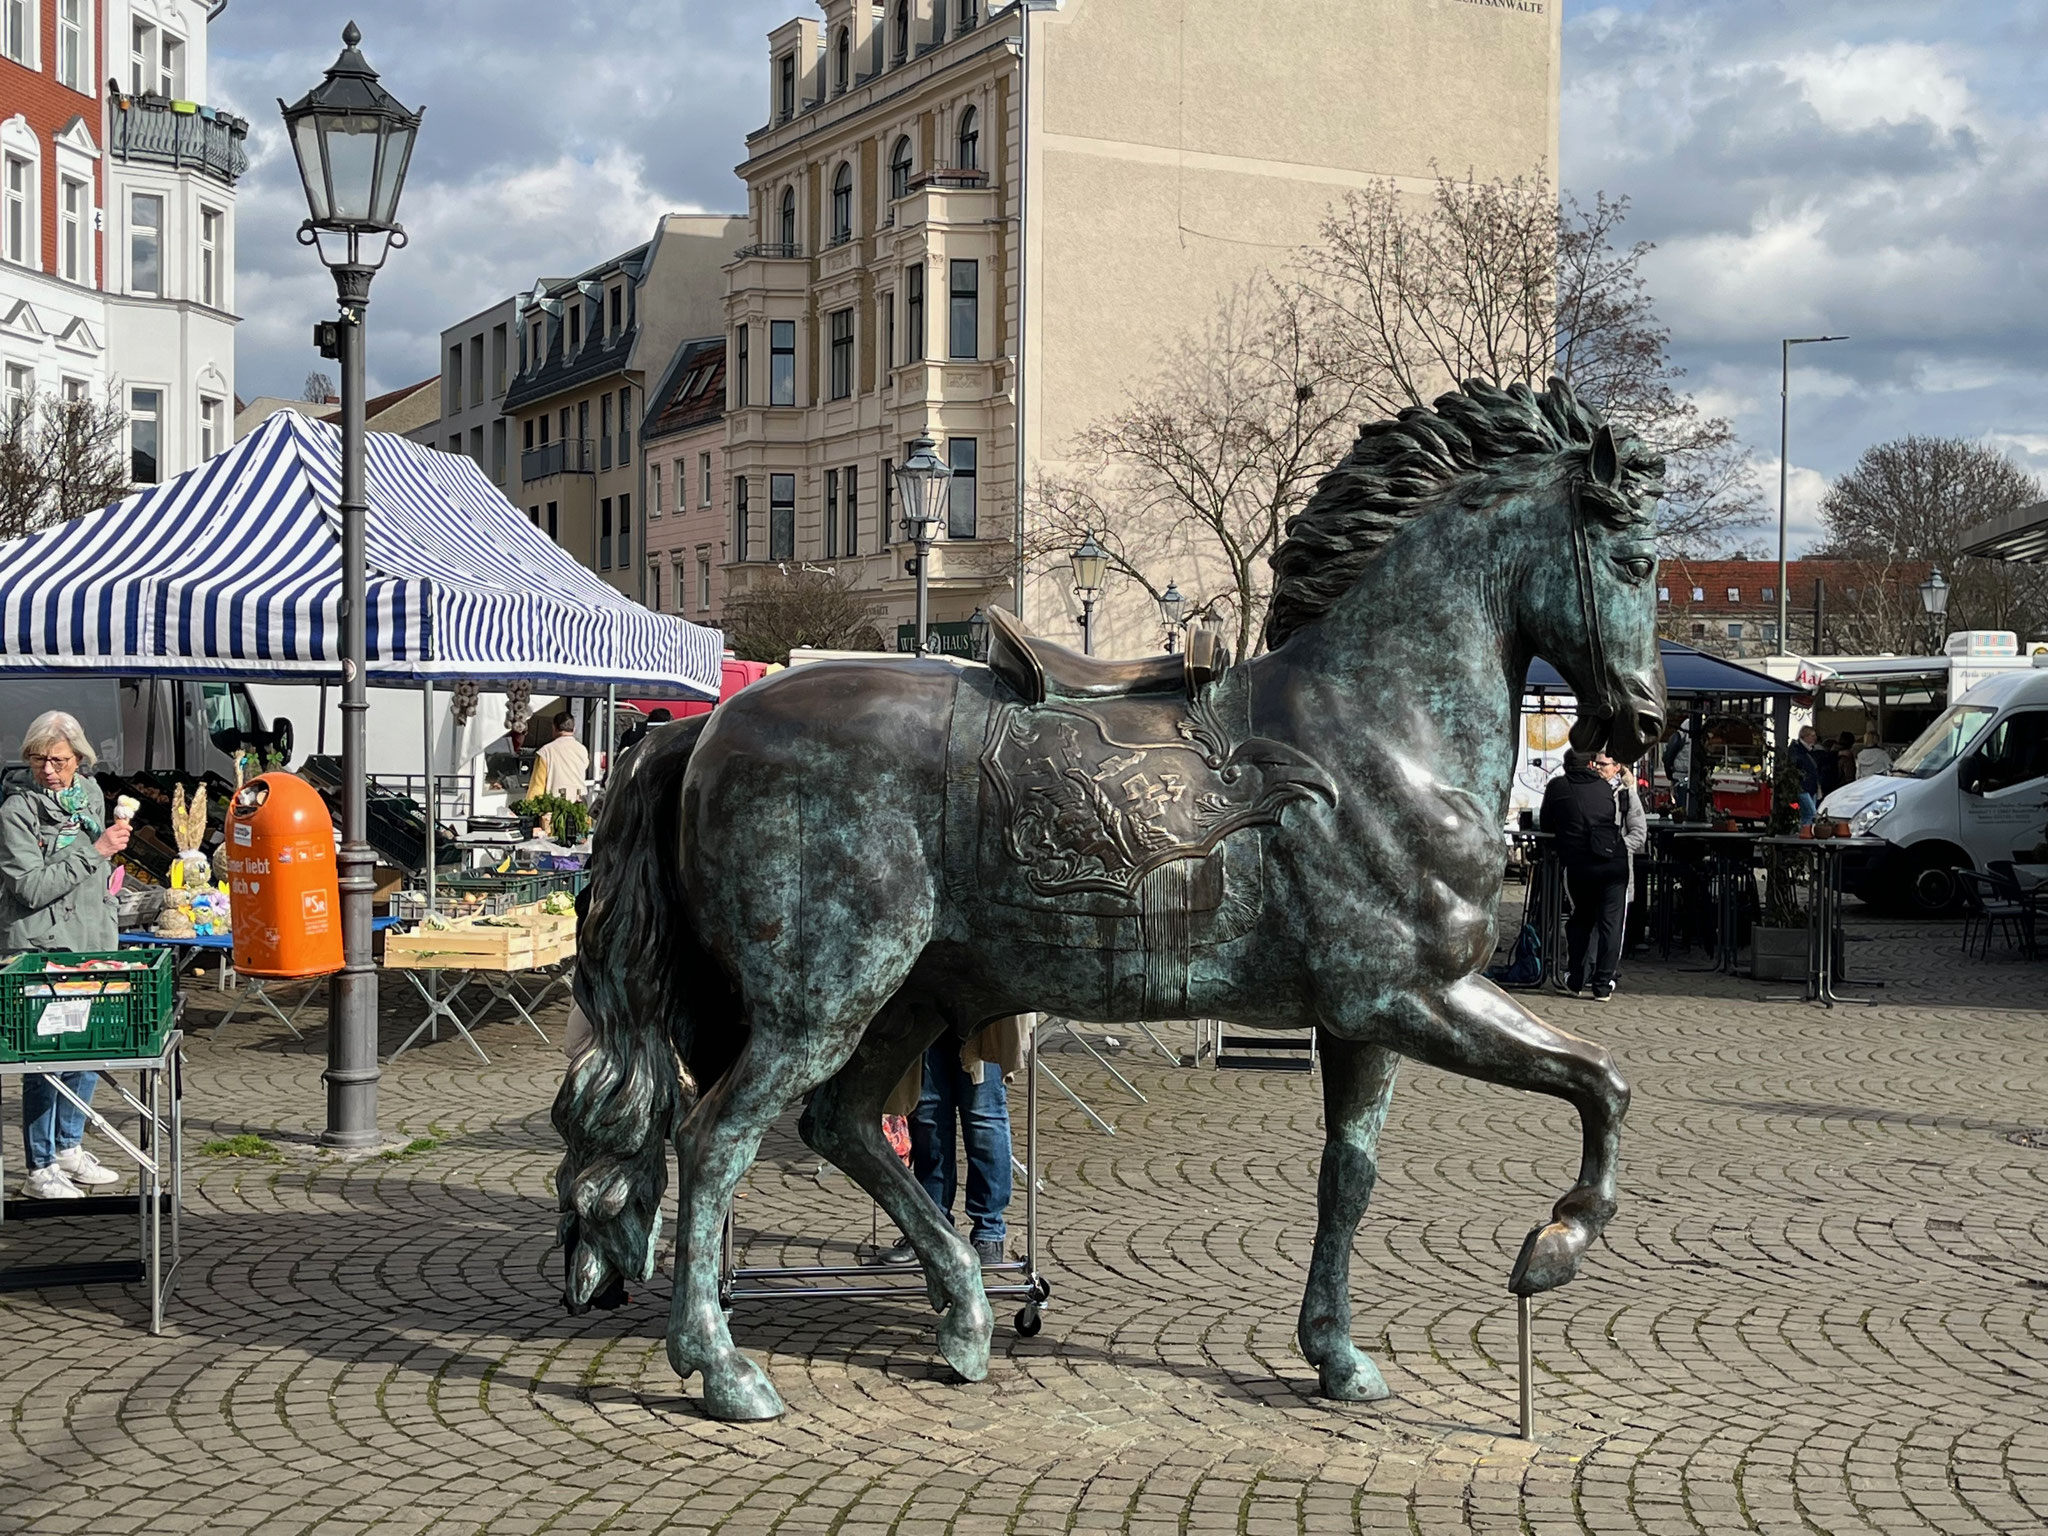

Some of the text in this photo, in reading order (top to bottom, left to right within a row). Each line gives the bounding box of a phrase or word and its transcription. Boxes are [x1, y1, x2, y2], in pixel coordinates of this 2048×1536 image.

[942, 634, 969, 651] HAUS
[245, 858, 270, 874] liebt
[232, 878, 248, 894] dich
